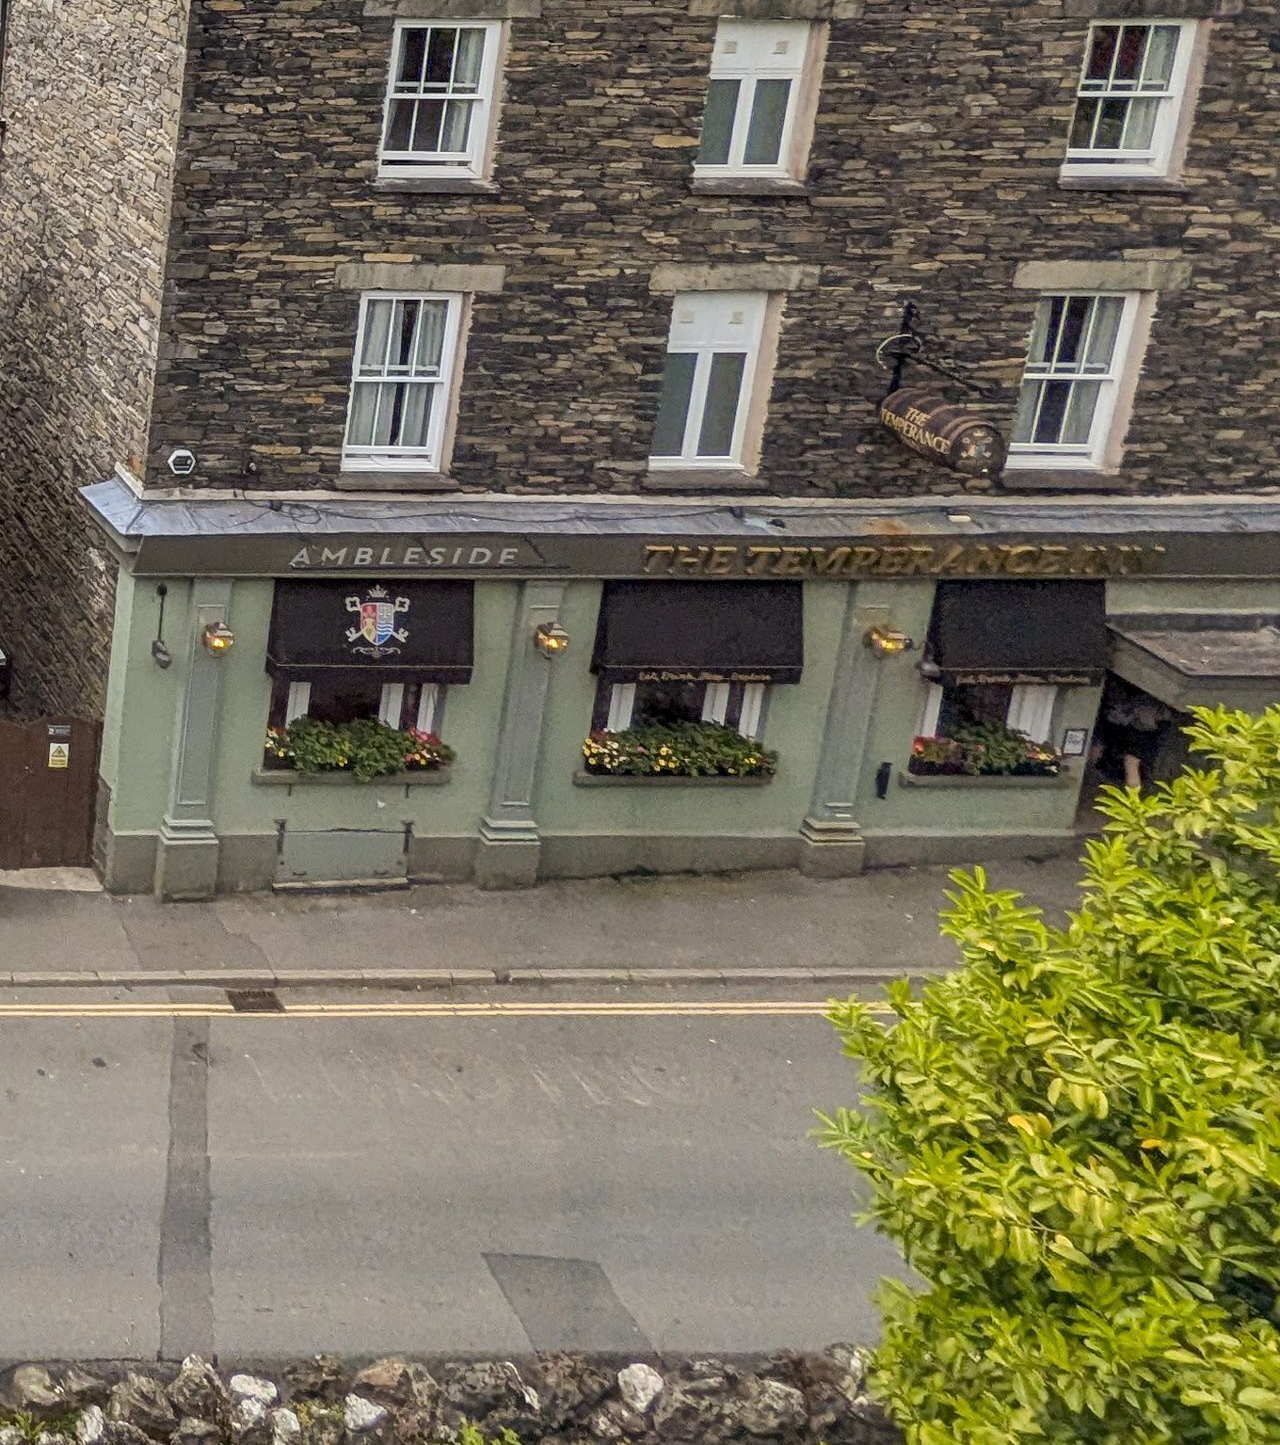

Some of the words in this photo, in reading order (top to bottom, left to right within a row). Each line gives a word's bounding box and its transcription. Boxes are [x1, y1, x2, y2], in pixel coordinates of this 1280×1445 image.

[905, 407, 932, 427] THE
[881, 408, 952, 455] TEMPERANCE
[290, 546, 519, 567] AMBLESIDE
[643, 545, 738, 574] THE
[744, 545, 1069, 574] TEMPERANCE
